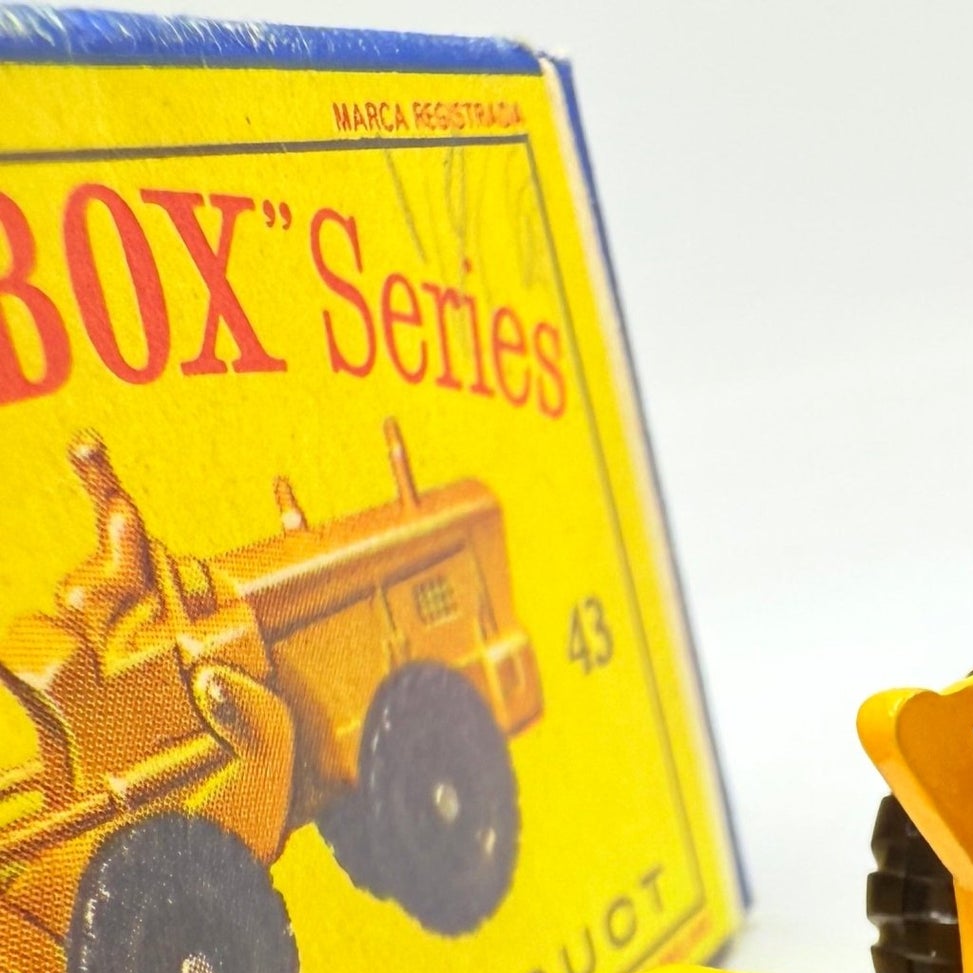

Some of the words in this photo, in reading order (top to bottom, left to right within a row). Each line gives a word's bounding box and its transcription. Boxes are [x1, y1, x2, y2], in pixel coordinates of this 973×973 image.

[332, 101, 409, 132] MARCA
[310, 207, 567, 420] Series
[567, 597, 614, 676] 43
